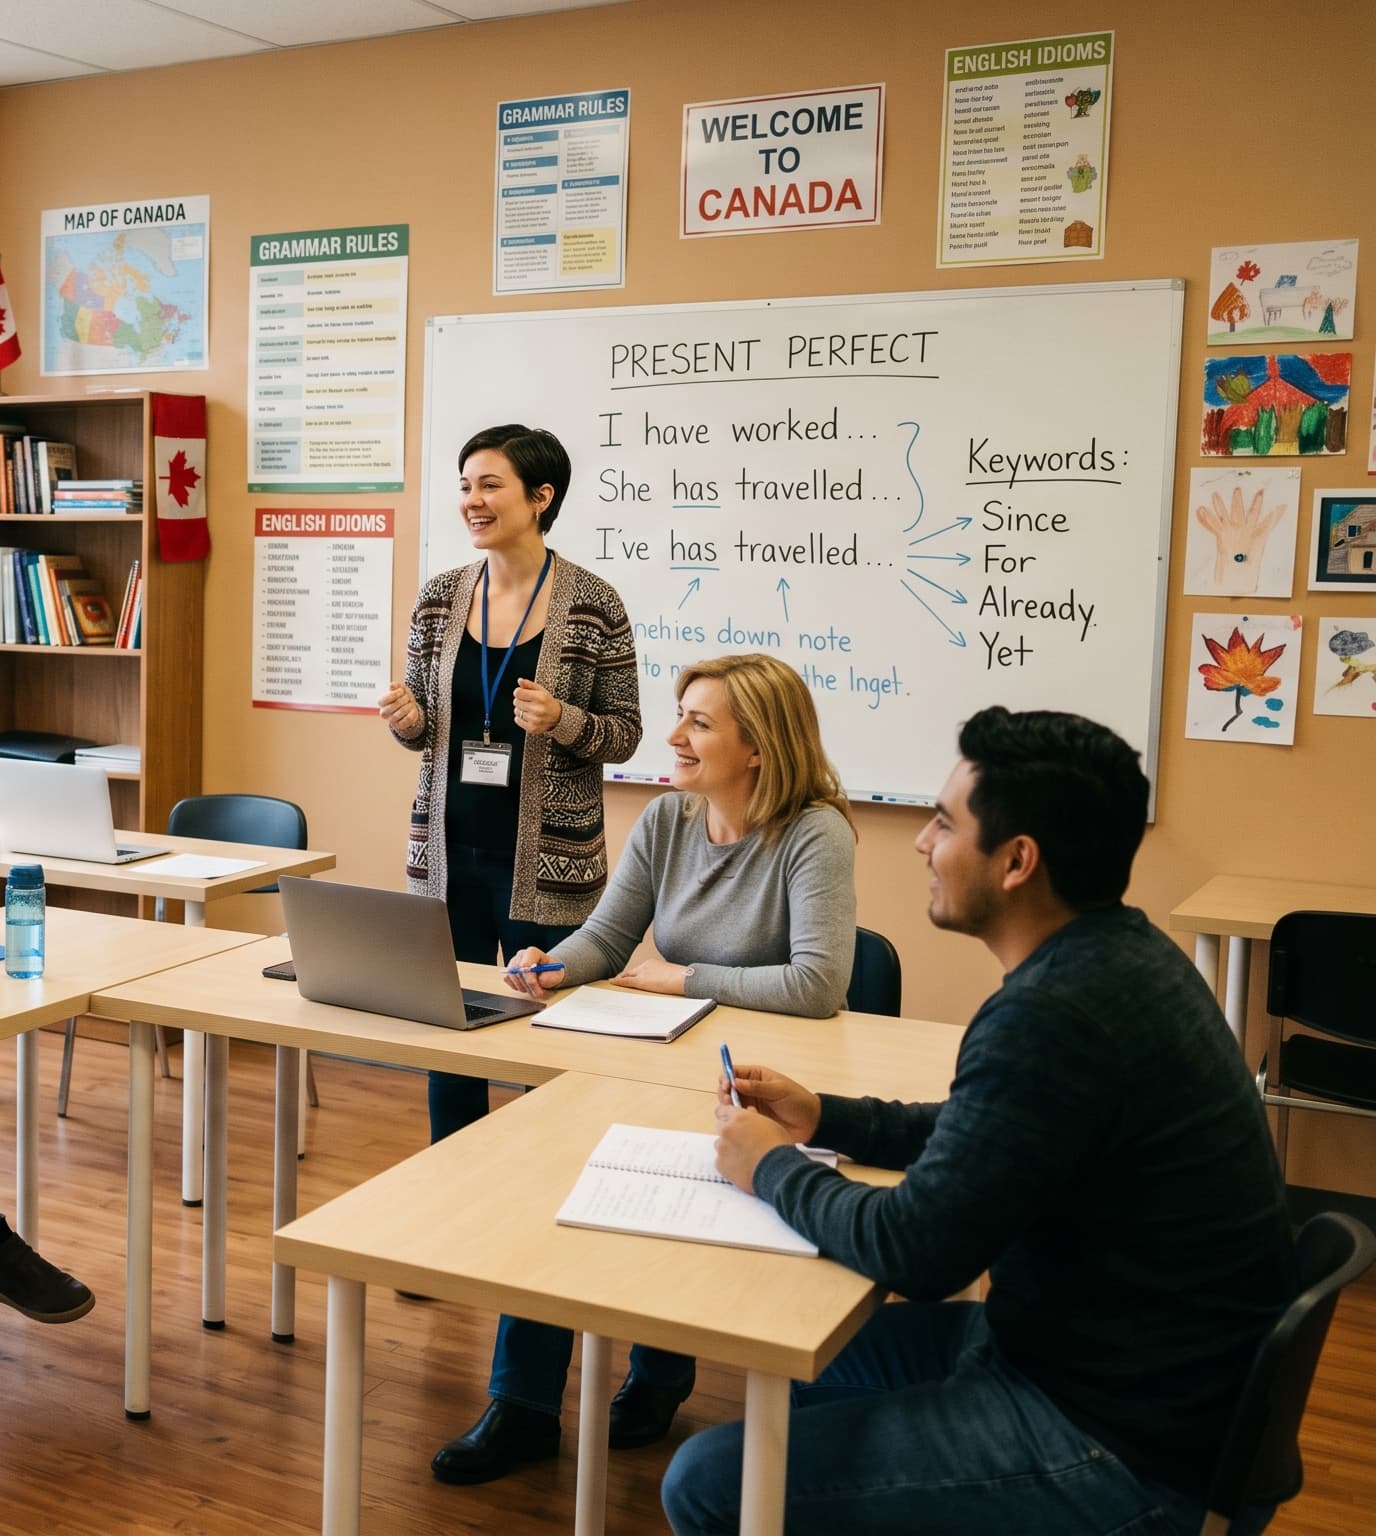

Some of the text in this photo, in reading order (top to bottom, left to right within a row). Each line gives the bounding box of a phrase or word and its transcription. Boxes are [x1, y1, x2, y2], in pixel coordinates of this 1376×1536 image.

[953, 41, 1106, 74] ENGLISH IDIOMS
[503, 97, 625, 125] GRAMMAR RULES
[701, 102, 864, 143] WELCOME
[759, 147, 800, 175] TO
[698, 179, 862, 220] CANADA
[64, 203, 186, 231] MAP OF CANADA
[259, 232, 399, 260] GRAMMAR RULES
[611, 330, 939, 379] PRESENT PERFECT
[599, 412, 622, 447] I
[645, 411, 710, 445] have
[969, 437, 1128, 489] Keywords:
[599, 468, 652, 502] She
[673, 468, 719, 501] has
[262, 513, 386, 532] ENGLISH IDIOMS
[982, 500, 1070, 532] Since
[595, 528, 650, 560] I've
[671, 529, 717, 562] has
[985, 545, 1036, 573] For
[717, 617, 781, 647] down
[799, 626, 852, 652] note
[979, 632, 1034, 670] Yet
[641, 654, 660, 677] to
[801, 664, 837, 690] the
